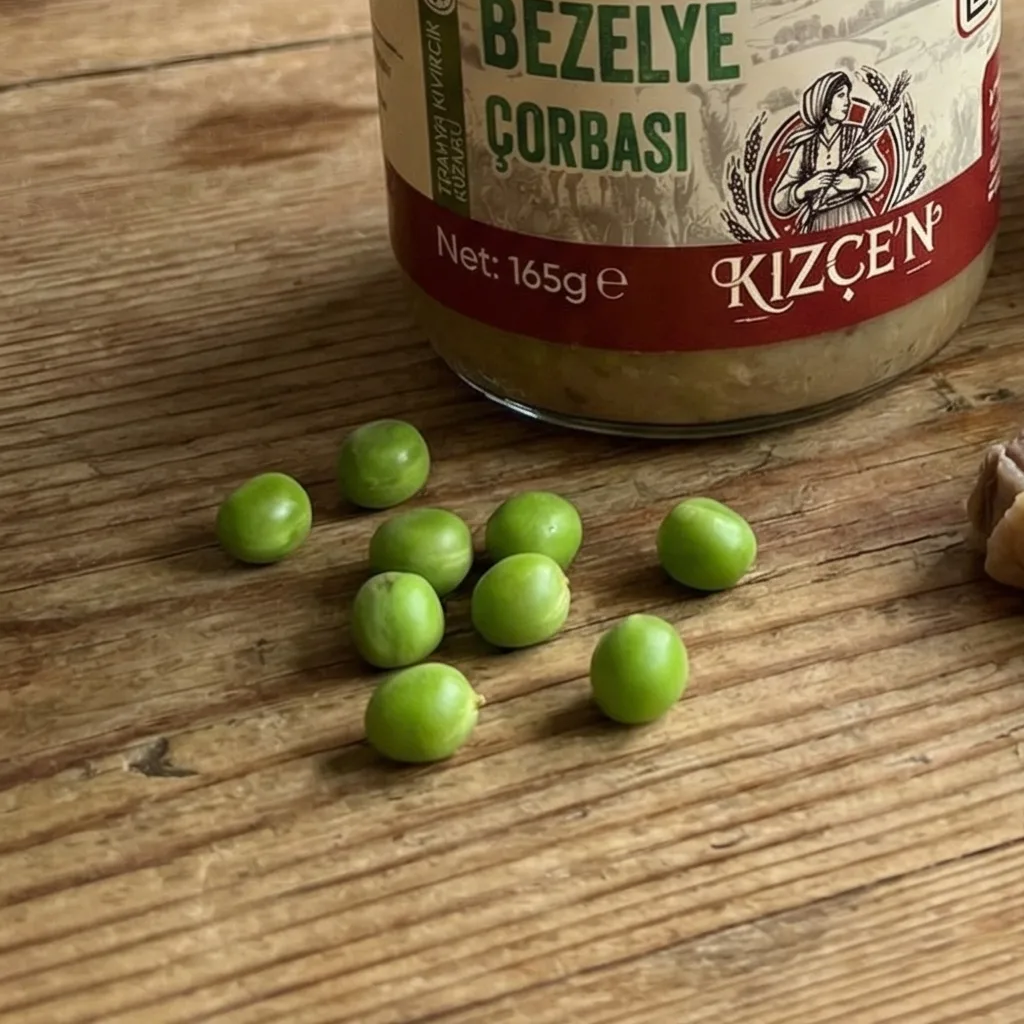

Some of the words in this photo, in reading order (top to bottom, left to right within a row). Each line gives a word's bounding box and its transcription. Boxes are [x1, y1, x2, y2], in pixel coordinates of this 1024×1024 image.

[485, 94, 689, 173] ÇORBASI
[436, 226, 500, 280] Net:
[508, 255, 588, 305] 165g
